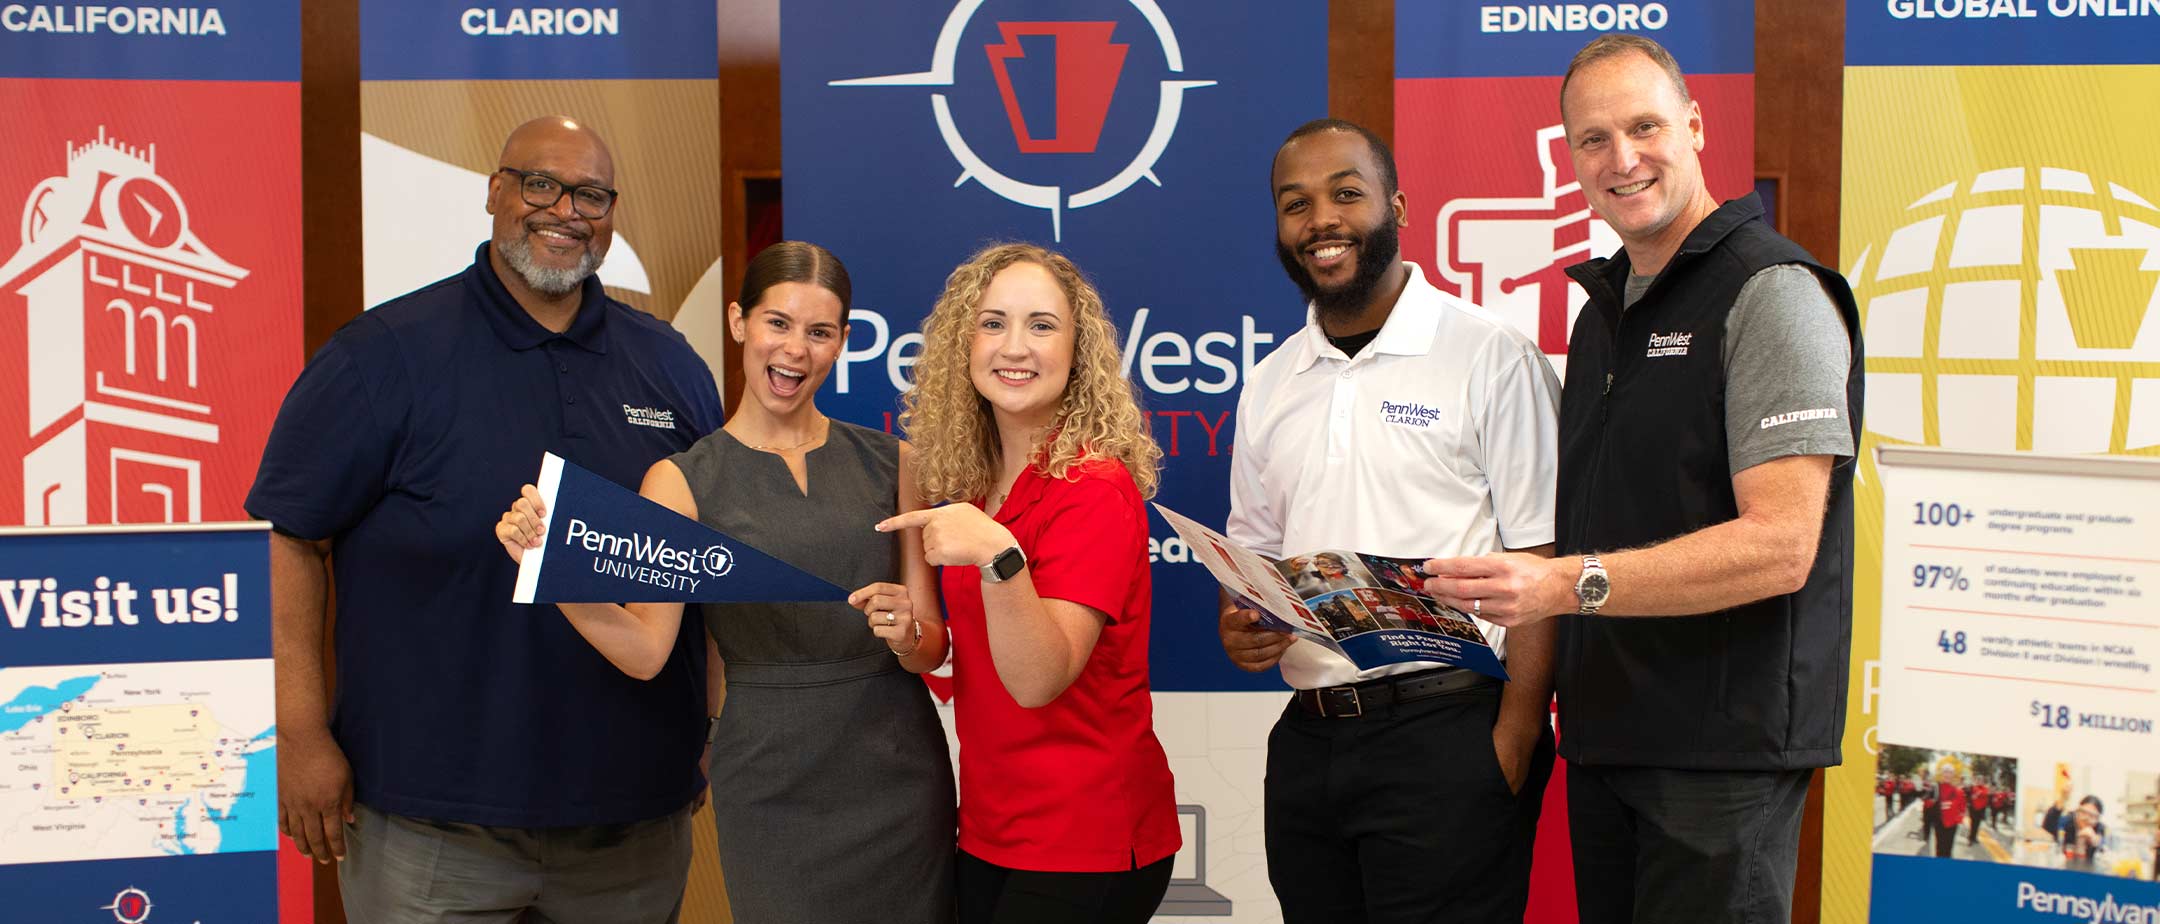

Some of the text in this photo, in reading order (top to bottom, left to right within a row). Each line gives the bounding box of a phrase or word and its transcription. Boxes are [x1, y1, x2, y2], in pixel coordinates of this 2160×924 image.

[0, 5, 227, 35] CALIFORNIA
[460, 8, 619, 35] CLARION
[1480, 3, 1668, 33] EDINBORO
[1887, 0, 2037, 19] GLOBAL
[1646, 347, 1688, 357] CALIFORNIA
[1648, 332, 1692, 348] PennWest
[623, 404, 675, 421] PennWest
[627, 416, 676, 429] CALIFORNIA
[1380, 400, 1440, 421] PennWest
[1385, 414, 1430, 427] CLARION
[1760, 408, 1838, 429] CALIFORNIA
[1913, 501, 1976, 527] 100+
[565, 518, 702, 574] PennWest
[593, 556, 701, 593] UNIVERSITY
[1913, 564, 1970, 592] 97%
[0, 573, 239, 628] Visit us!
[1389, 640, 1421, 648] Right
[1422, 641, 1437, 649] for
[1415, 634, 1462, 648] Program
[1937, 630, 1967, 655] 48
[2031, 700, 2152, 734] $18 MILLION
[2017, 881, 2160, 924] Pennsylvan
